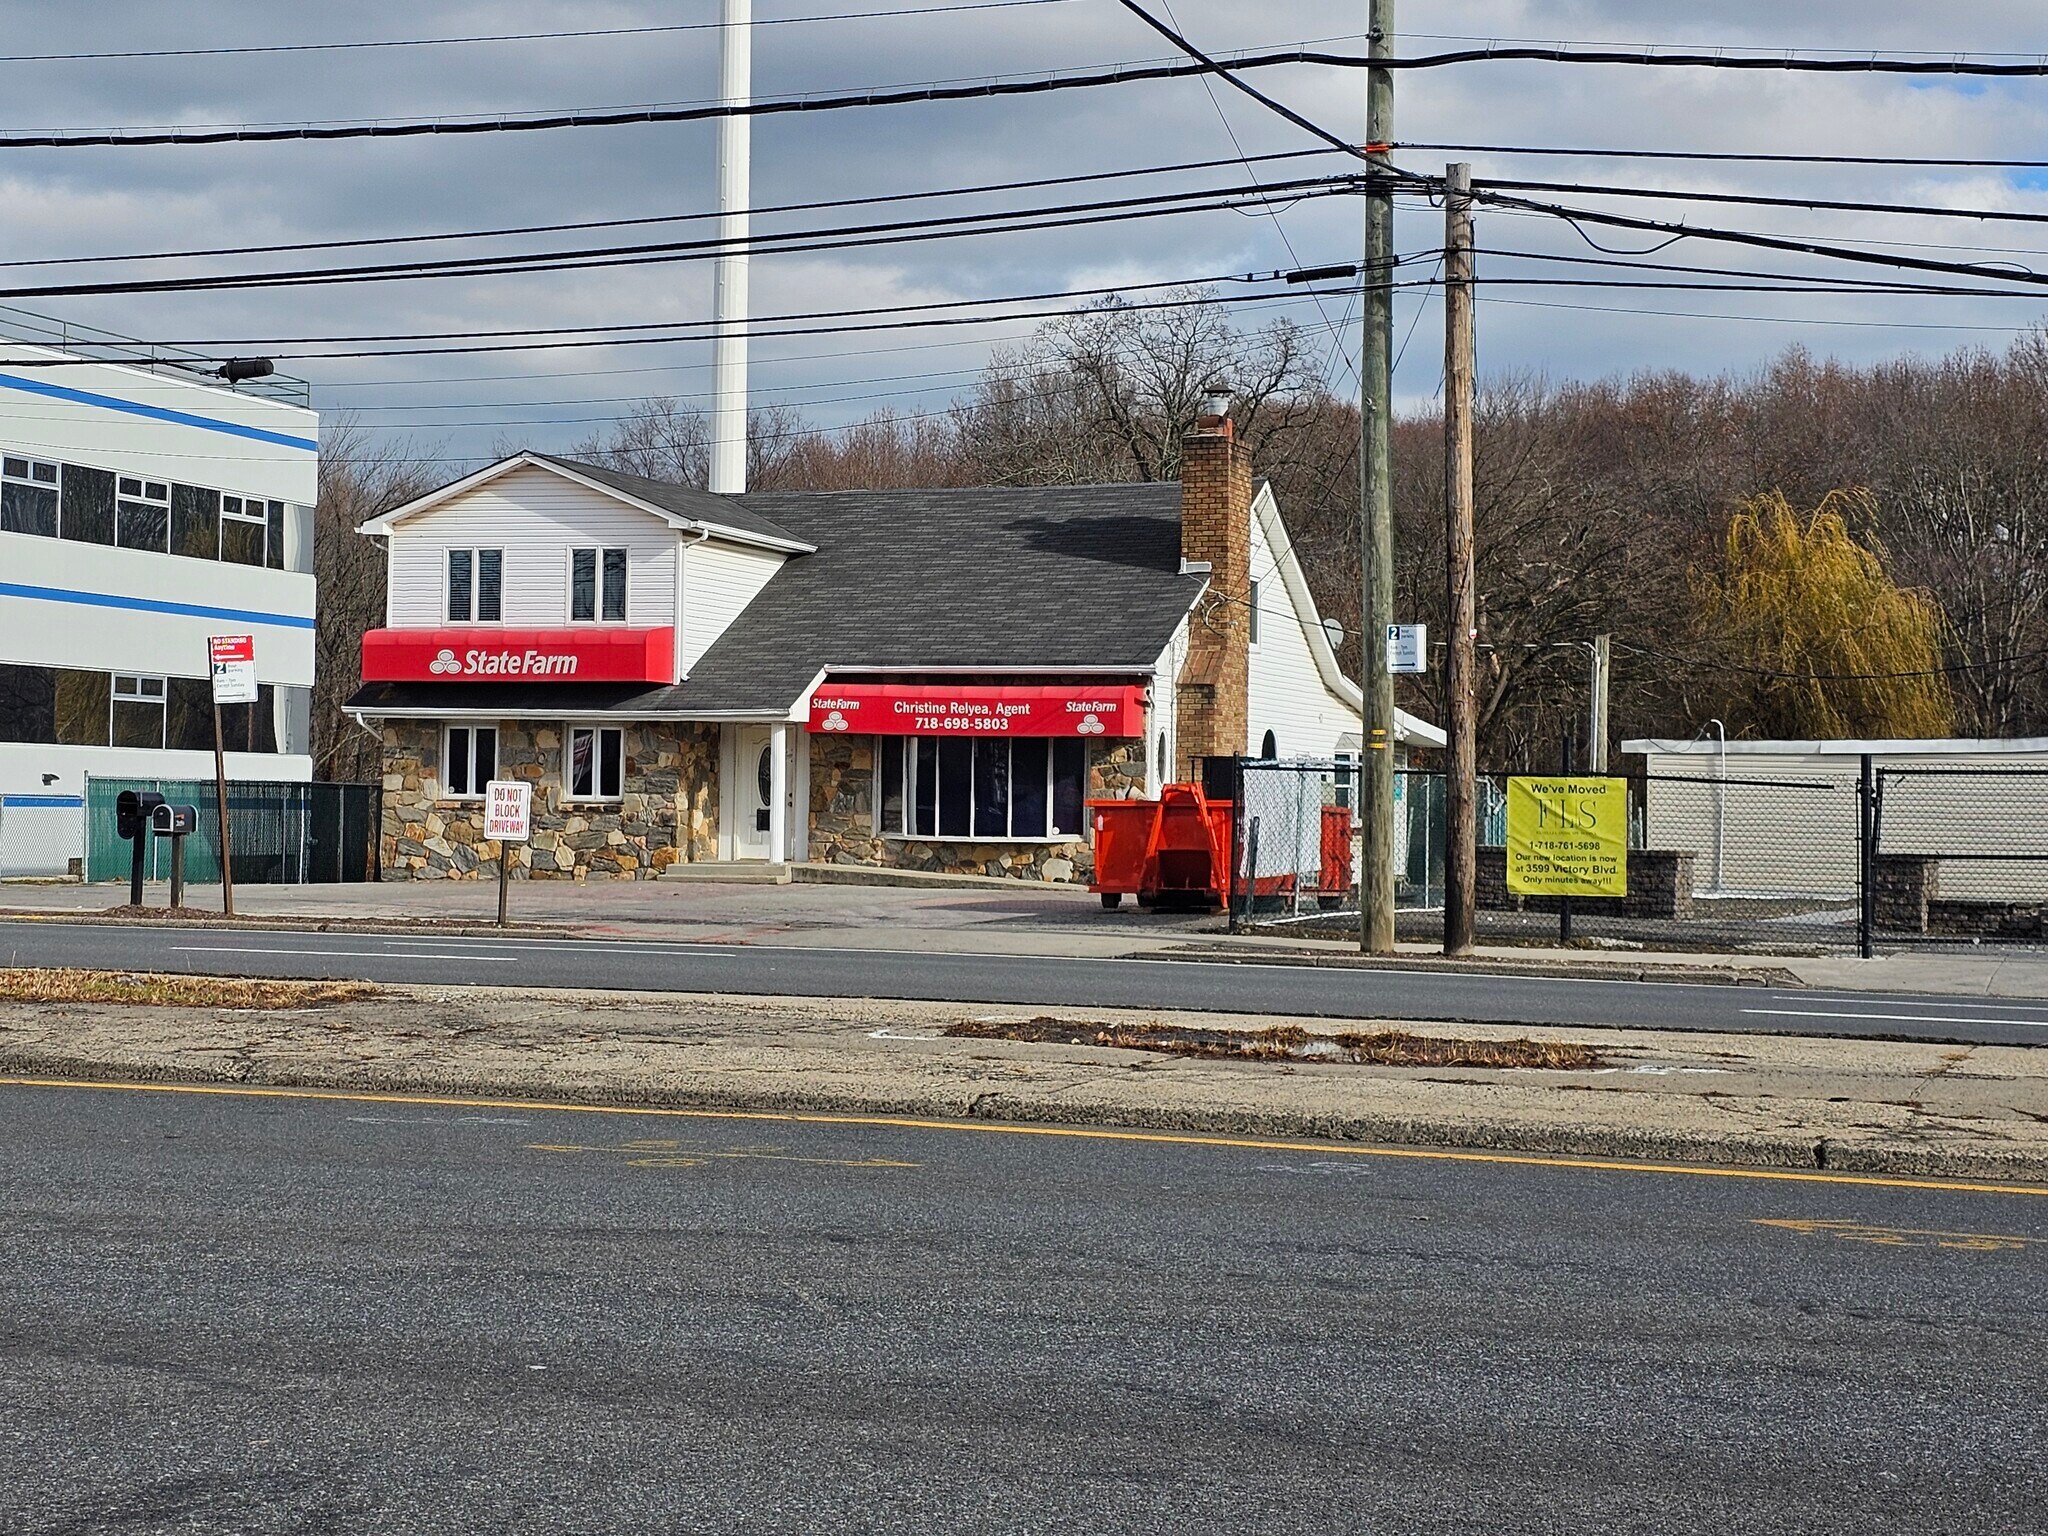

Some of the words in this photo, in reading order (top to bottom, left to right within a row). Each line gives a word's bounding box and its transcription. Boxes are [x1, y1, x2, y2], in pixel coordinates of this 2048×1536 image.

[1391, 627, 1398, 639] 2
[217, 664, 224, 674] 2
[894, 701, 947, 714] Christine
[950, 702, 992, 716] Relyea,
[995, 703, 1031, 717] Agent
[915, 717, 1009, 730] 718-698-5803
[494, 787, 505, 802] DO
[507, 788, 523, 802] NOT
[1531, 784, 1565, 794] We've
[1568, 784, 1606, 794] Moved
[495, 803, 521, 818] BLOCK
[489, 819, 525, 834] DRIVEWAY
[1529, 841, 1601, 850] 1-718-761-5698
[1515, 853, 1531, 861] Our
[1553, 854, 1586, 862] location
[1526, 864, 1550, 873] 3599
[1552, 864, 1589, 875] Victory
[1522, 875, 1543, 885] Only
[1544, 876, 1579, 884] minutes
